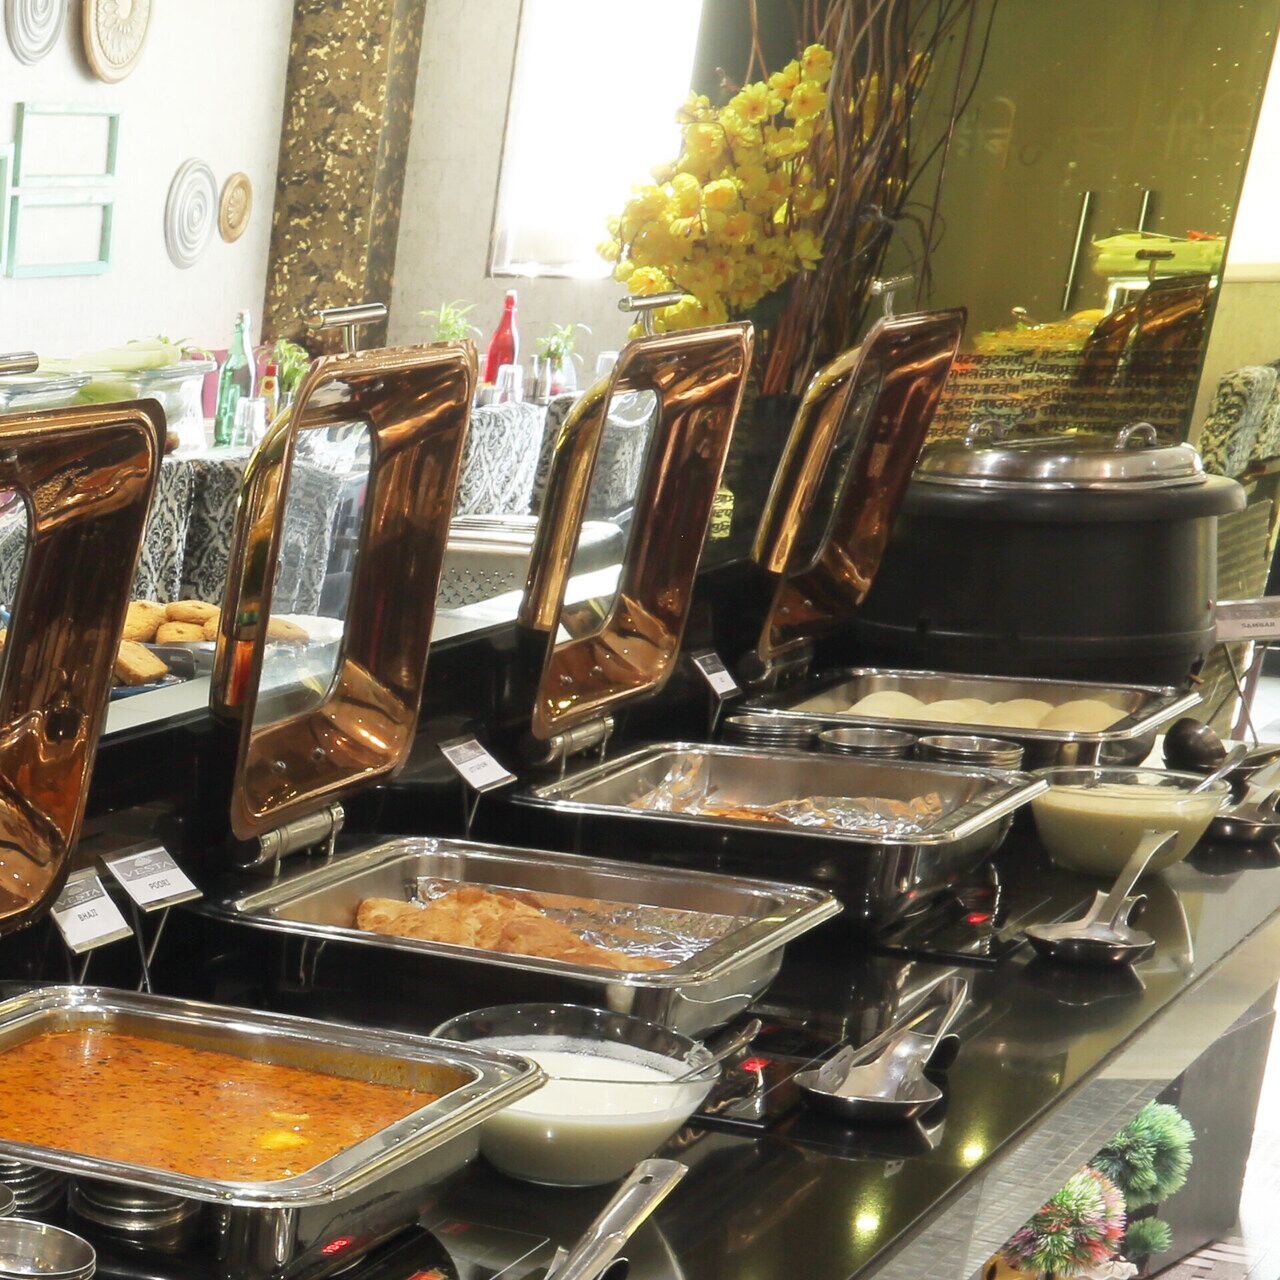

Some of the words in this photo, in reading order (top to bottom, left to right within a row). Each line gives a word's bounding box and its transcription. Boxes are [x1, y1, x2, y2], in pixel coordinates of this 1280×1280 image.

[122, 861, 173, 878] VESTA
[148, 879, 171, 890] POORI
[56, 889, 101, 906] VESTA
[77, 909, 99, 922] BHAJI
